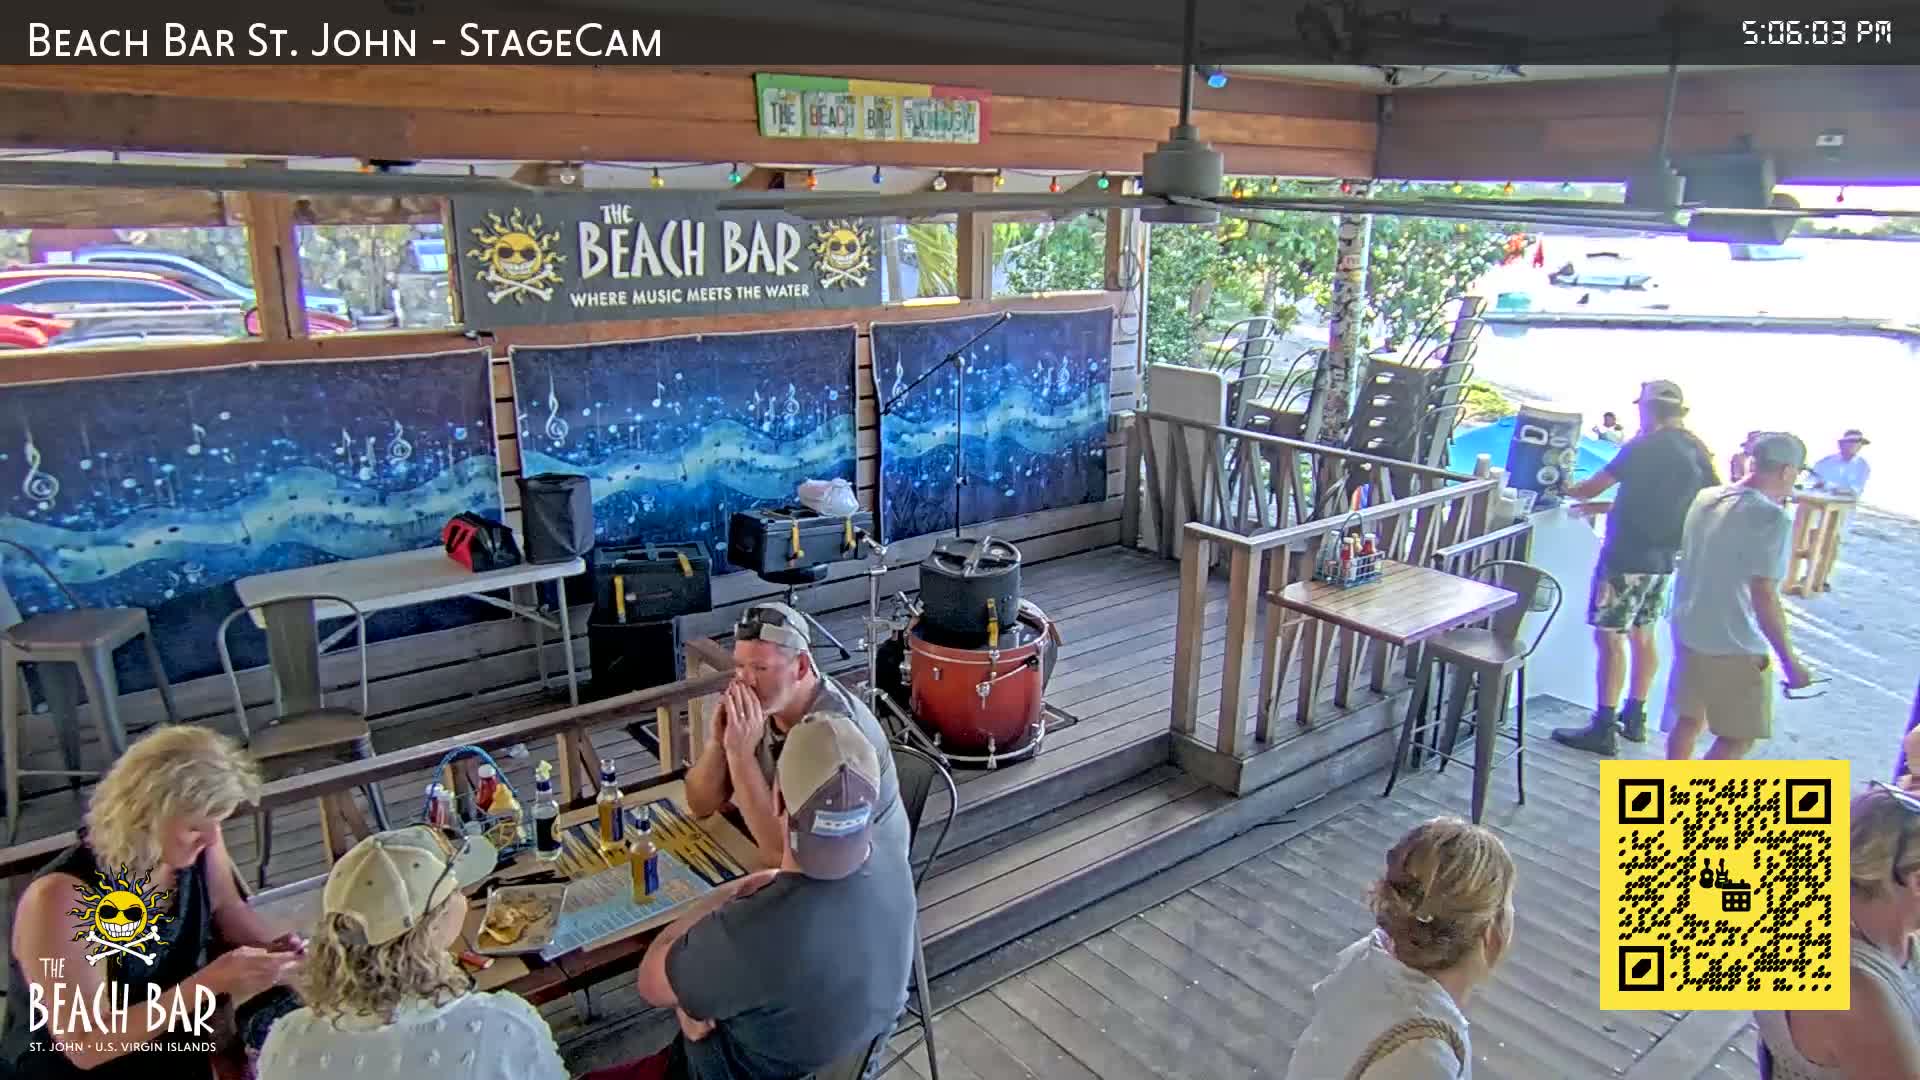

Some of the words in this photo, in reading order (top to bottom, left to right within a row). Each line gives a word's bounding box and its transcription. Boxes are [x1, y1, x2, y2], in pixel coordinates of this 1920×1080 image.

[770, 102, 796, 126] THE
[810, 104, 856, 128] BEACH
[600, 203, 634, 225] THE
[578, 220, 706, 279] BEACH
[723, 220, 801, 276] BAR
[570, 291, 628, 307] WHERE
[633, 289, 682, 305] MUSIC
[686, 287, 732, 302] MEETS
[736, 286, 762, 300] THE
[765, 284, 810, 299] WATER
